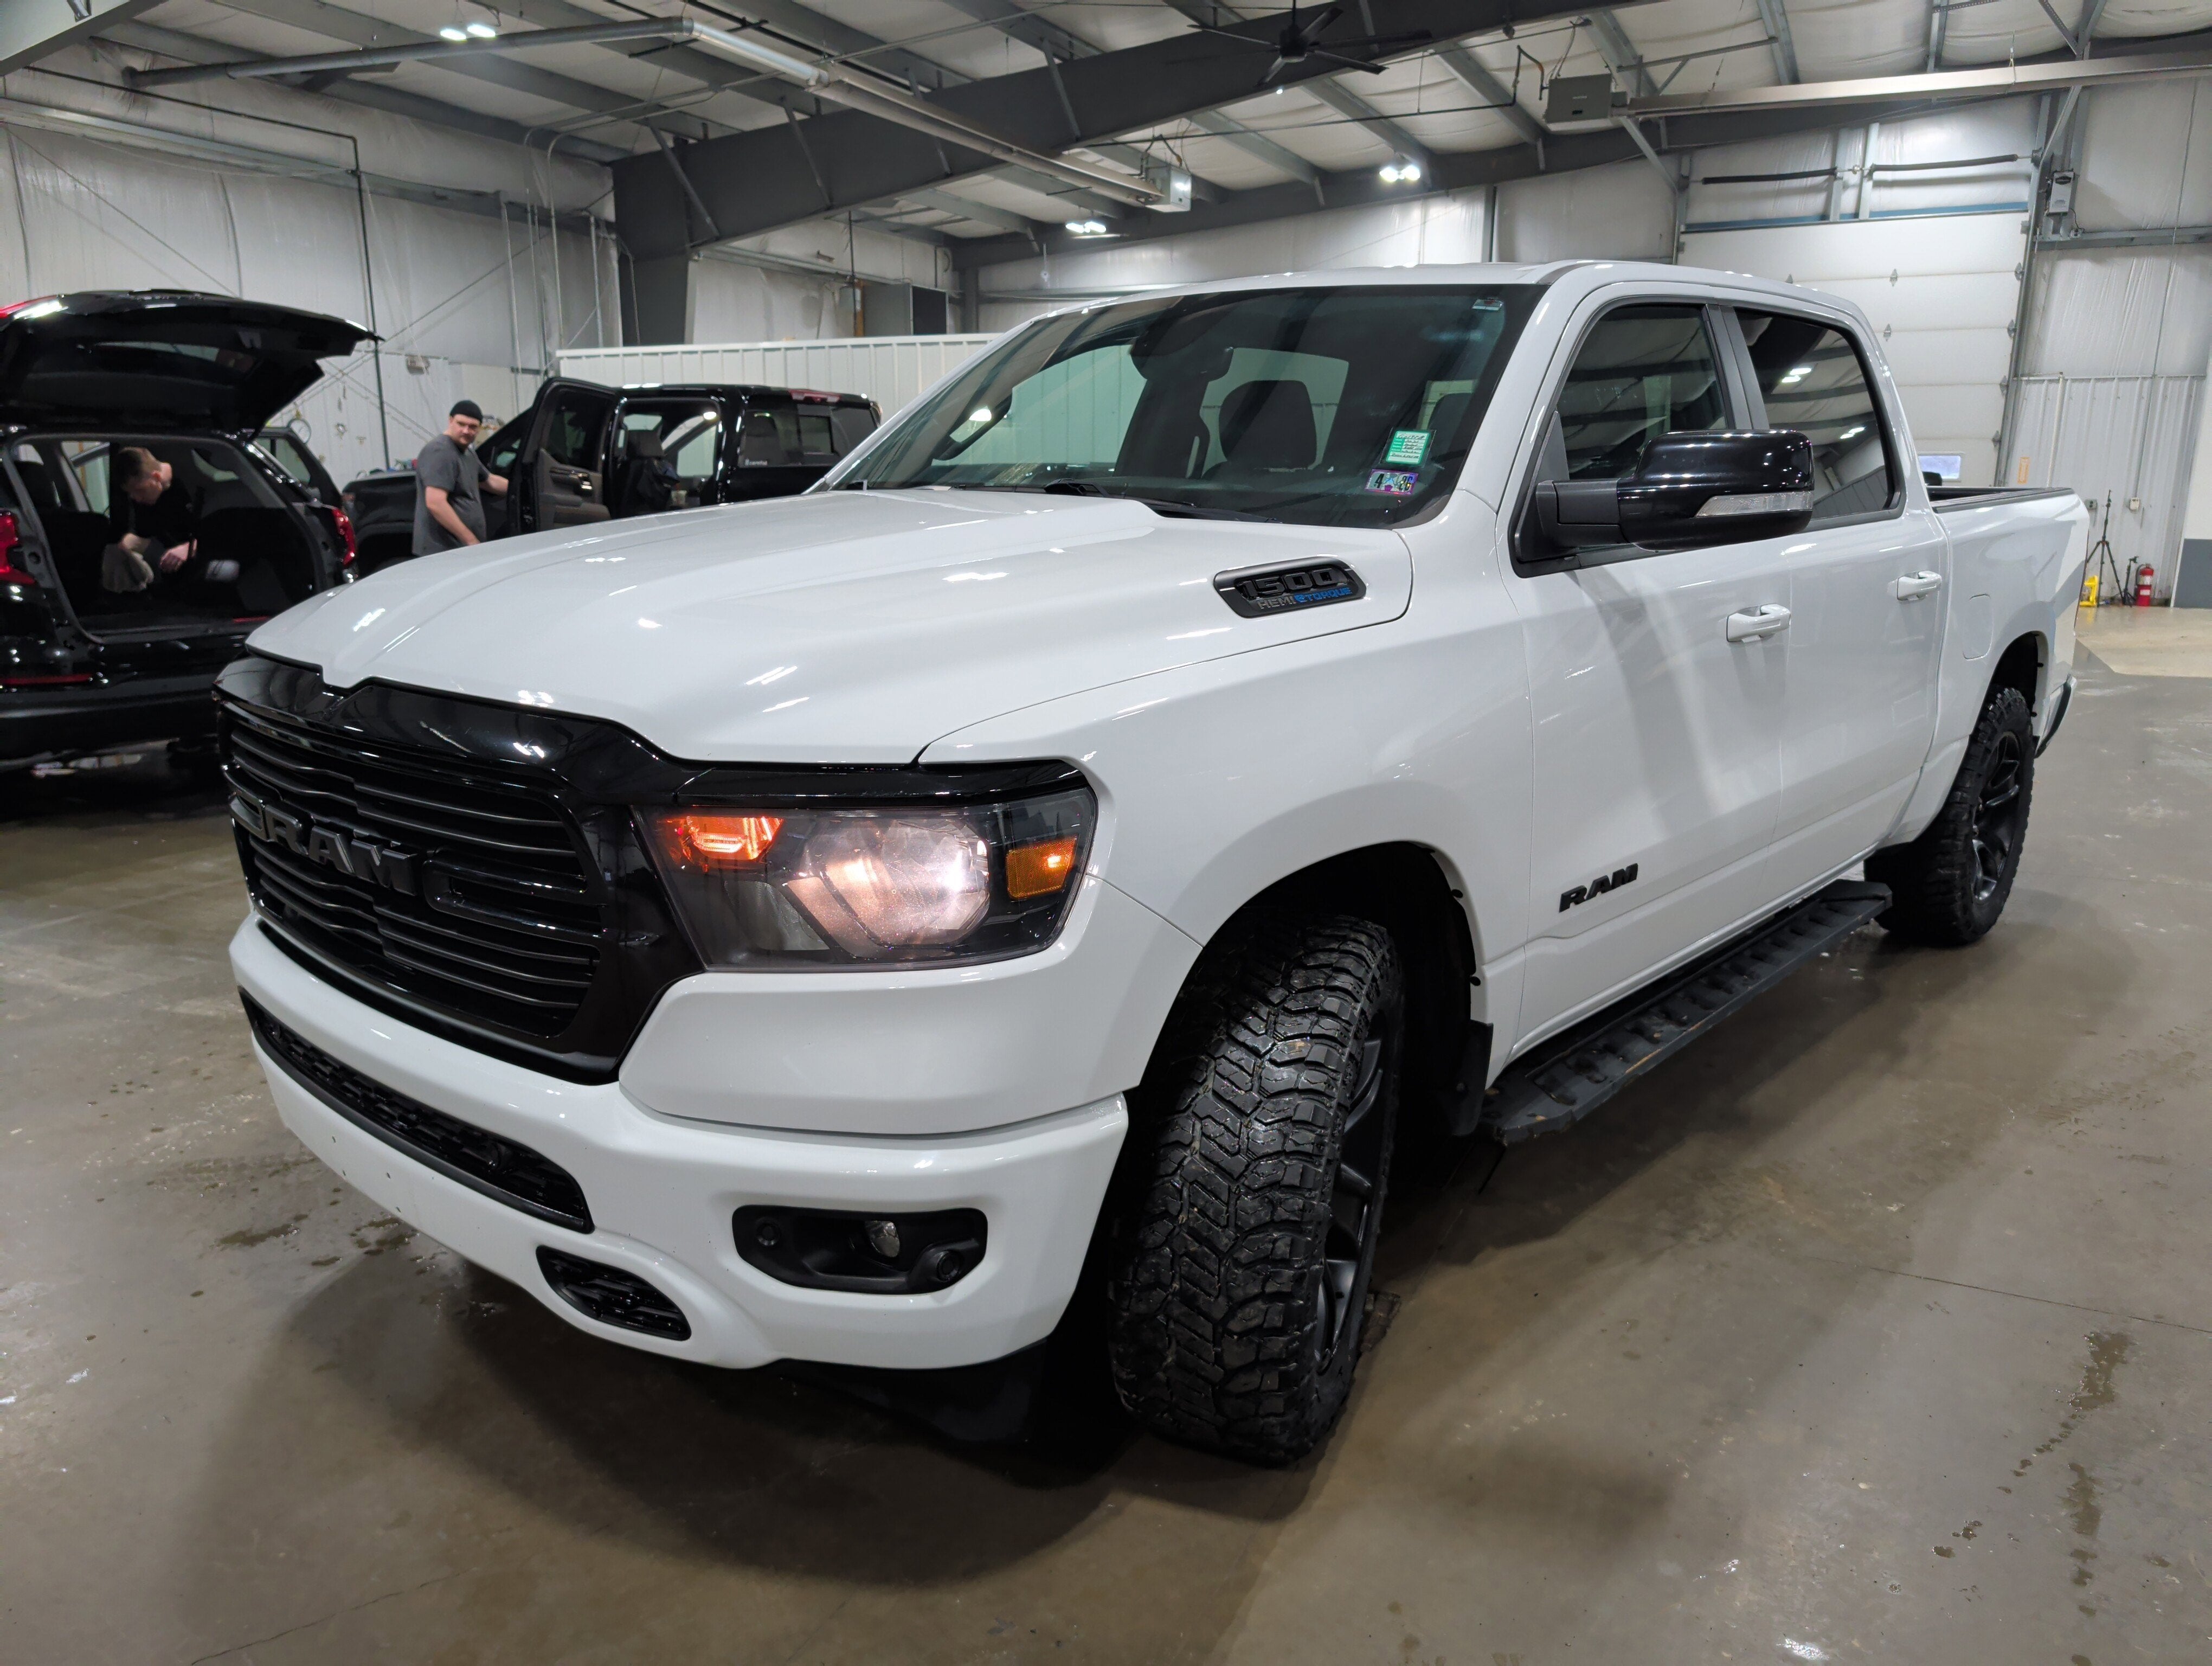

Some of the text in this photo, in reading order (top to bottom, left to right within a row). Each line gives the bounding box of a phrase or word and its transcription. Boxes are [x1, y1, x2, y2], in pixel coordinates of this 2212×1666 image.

[1374, 473, 1385, 489] 4
[1236, 568, 1349, 600] 1500
[1257, 596, 1296, 610] HEMI
[265, 804, 419, 896] RAM
[1559, 863, 1638, 913] RAM
